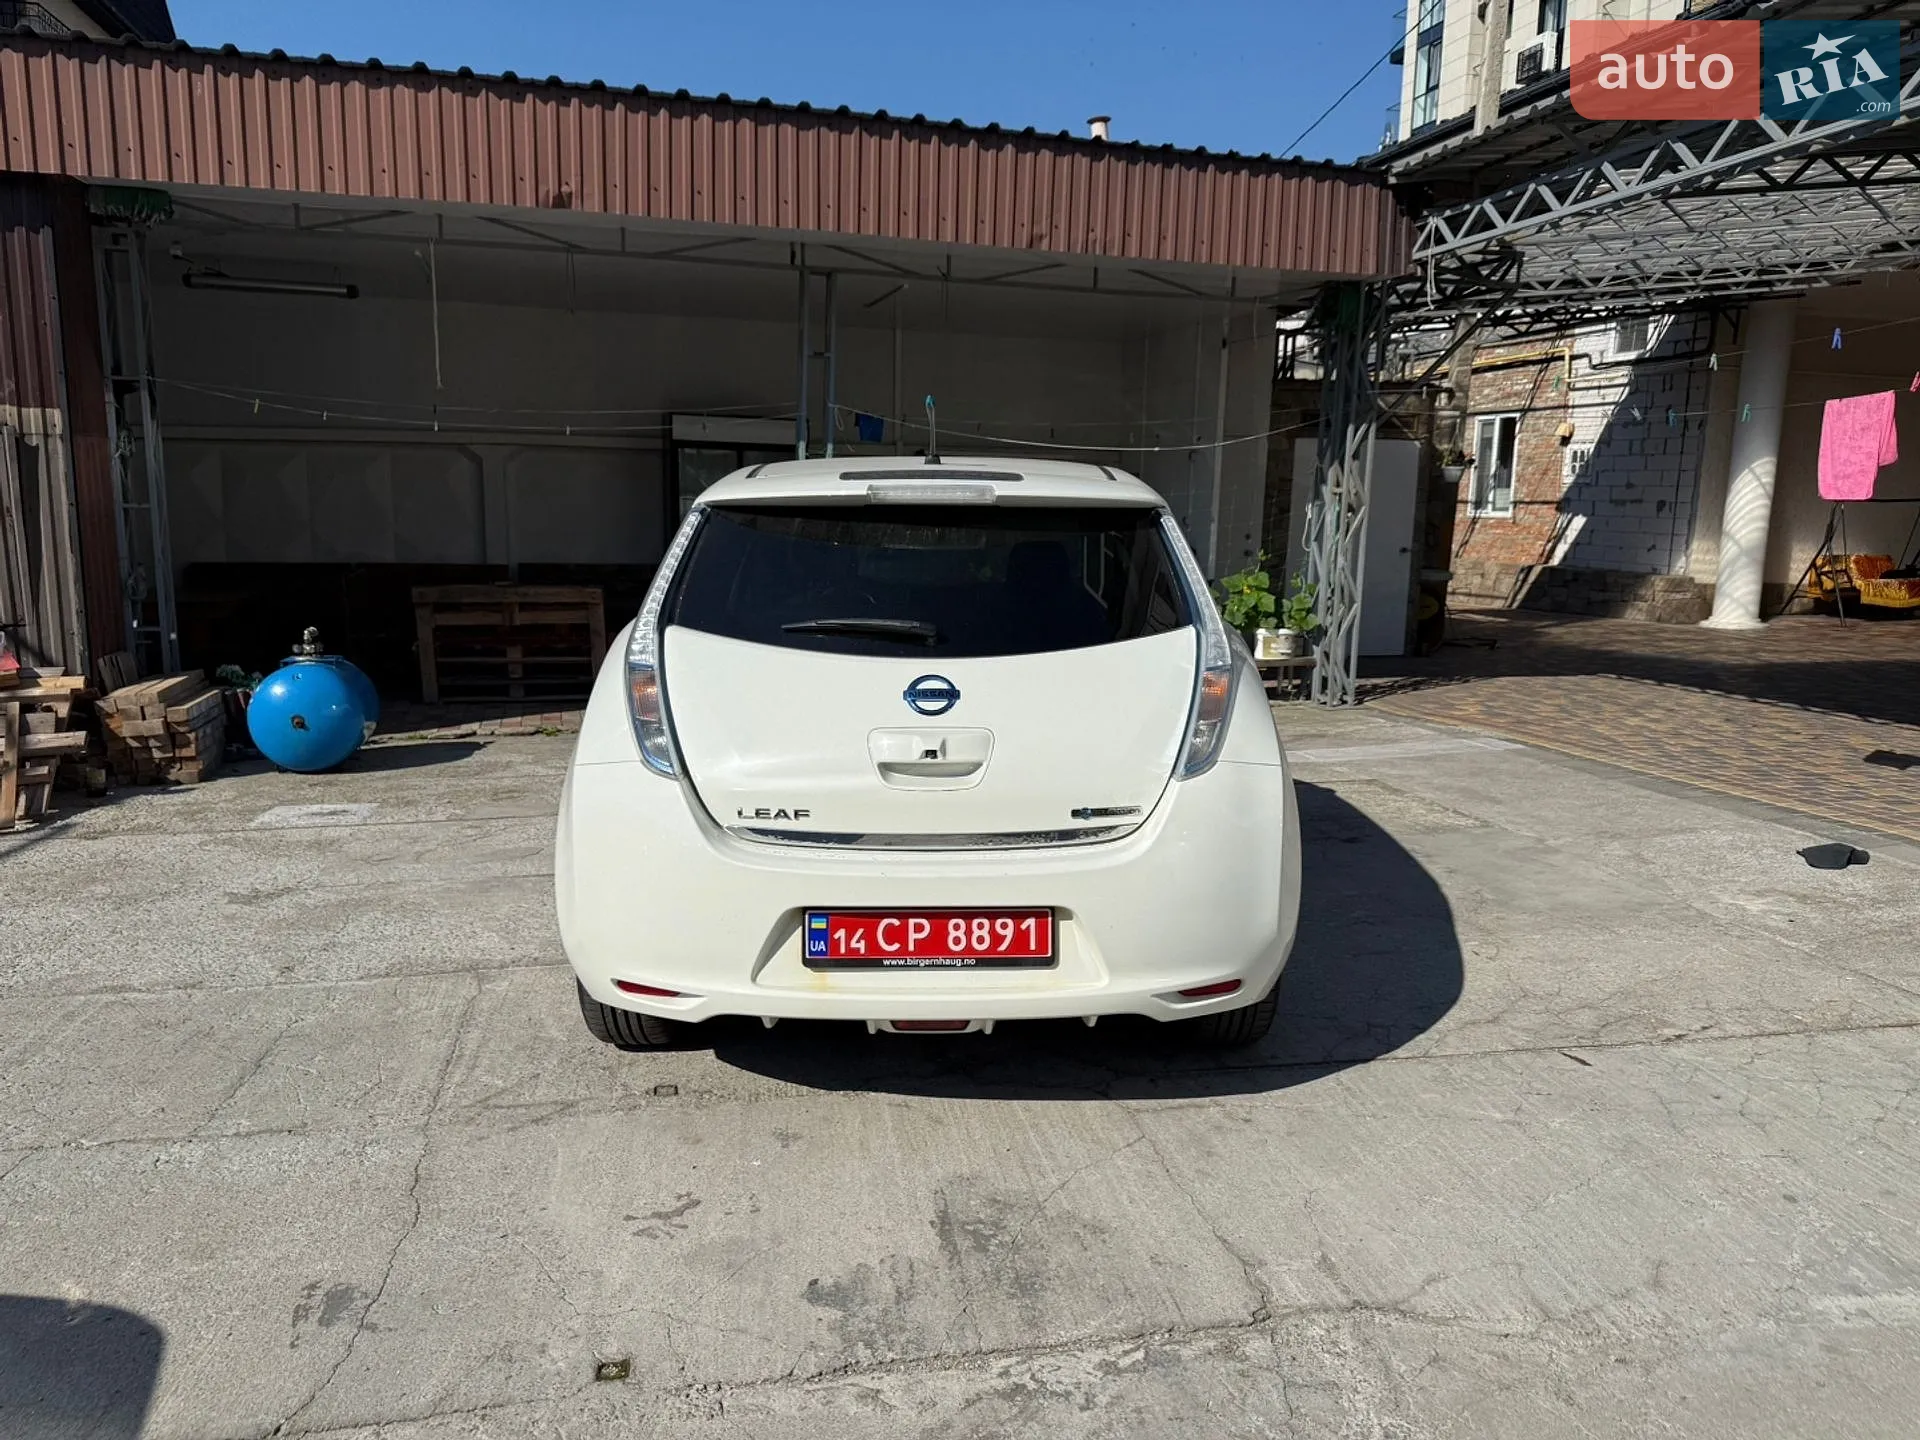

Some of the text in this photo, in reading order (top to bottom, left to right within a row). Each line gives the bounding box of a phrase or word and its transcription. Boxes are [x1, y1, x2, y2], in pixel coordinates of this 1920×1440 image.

[737, 807, 810, 821] LEAF
[833, 917, 1037, 955] 14 CP 8891
[810, 940, 826, 952] UA
